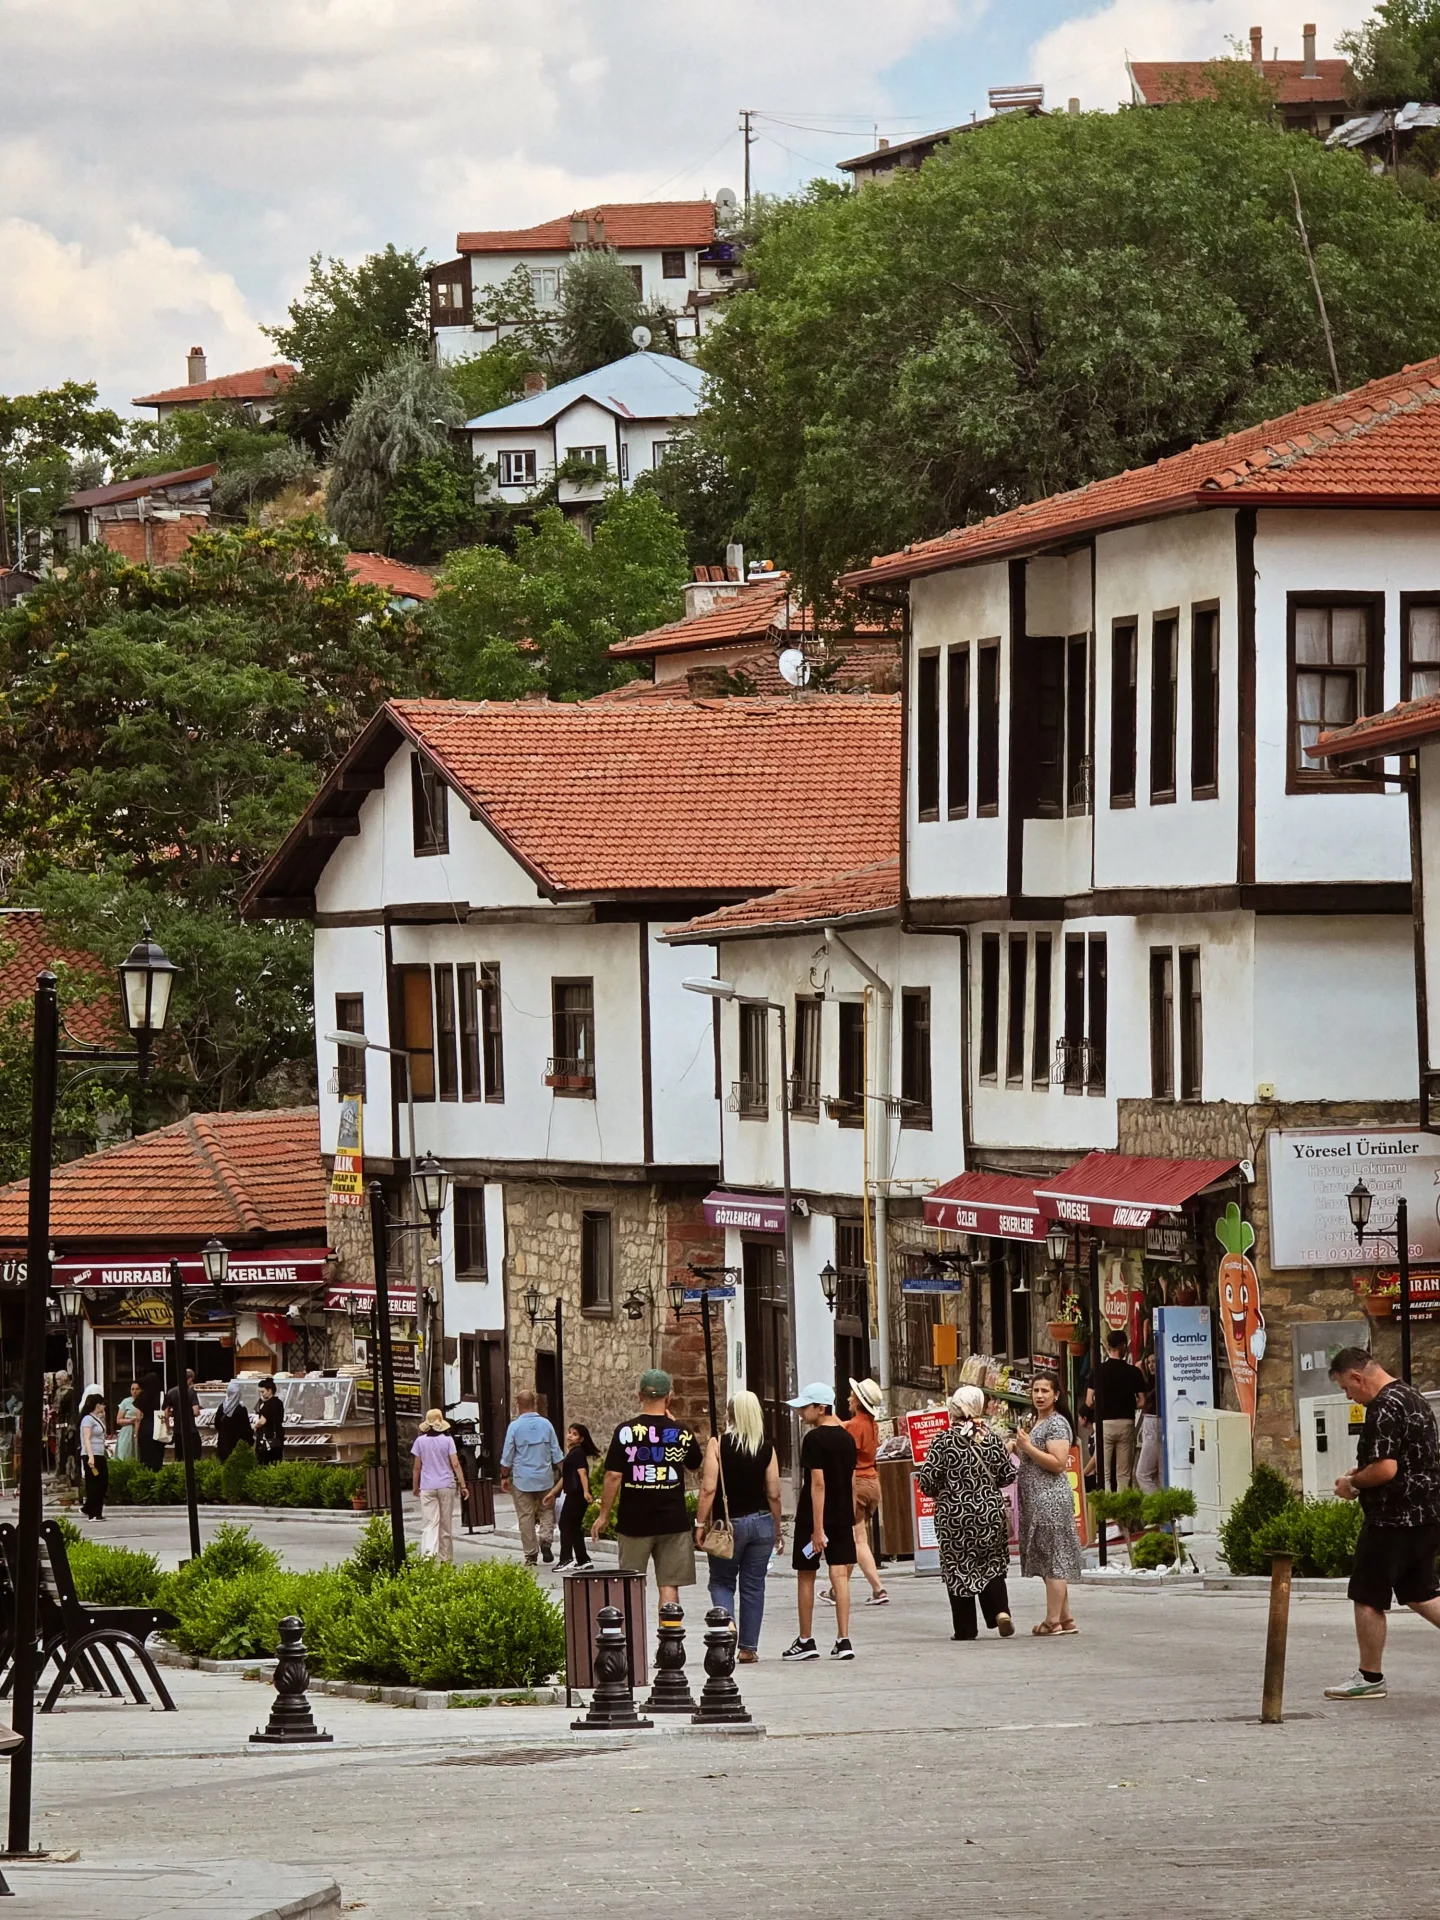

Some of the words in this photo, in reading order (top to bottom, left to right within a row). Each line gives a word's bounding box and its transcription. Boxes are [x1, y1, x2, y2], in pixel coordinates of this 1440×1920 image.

[1293, 1142, 1352, 1158] Yöresel
[1356, 1138, 1420, 1156] Ürünler
[1308, 1164, 1350, 1178] Havuç
[1353, 1162, 1407, 1176] Lokumu
[350, 1175, 358, 1183] EV
[340, 1194, 350, 1205] 94
[351, 1195, 360, 1205] 27
[1317, 1196, 1349, 1210] Havu
[1372, 1194, 1400, 1210] eçeli
[956, 1206, 977, 1228] ÖZLEM
[999, 1214, 1034, 1235] ŞEKERLEME
[1056, 1199, 1091, 1222] YÖRESEL
[1112, 1205, 1151, 1227] ÜRÜNLER
[1316, 1213, 1348, 1228] Ayva
[1300, 1250, 1326, 1261] TEL:
[1329, 1249, 1338, 1260] 0
[1340, 1248, 1362, 1259] 312
[1365, 1246, 1388, 1257] 762
[0, 1259, 28, 1286] ÜŞ
[226, 1267, 298, 1281] KERLEME
[1105, 1296, 1127, 1316] özlem
[1172, 1332, 1208, 1344] damla
[1170, 1355, 1189, 1363] Doğal
[1172, 1374, 1210, 1382] kaynağında
[1180, 1367, 1202, 1375] cevabı
